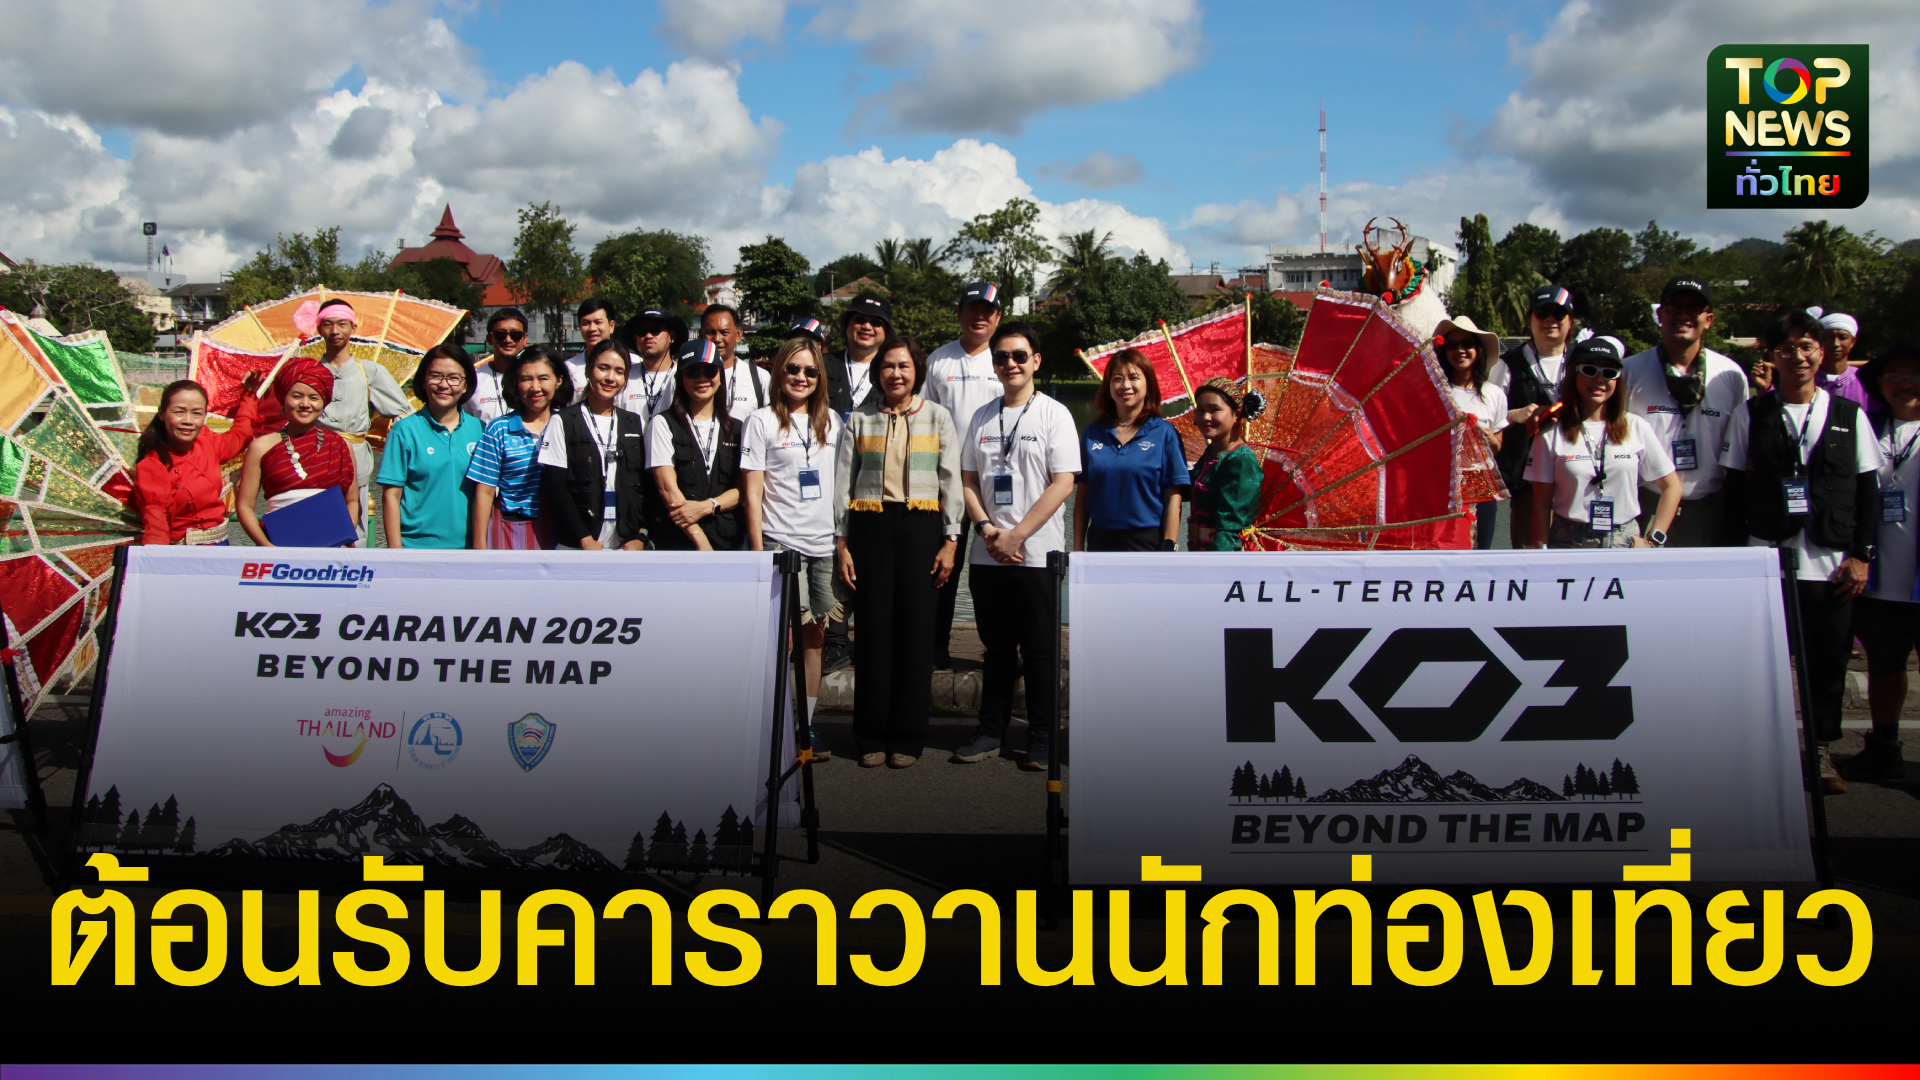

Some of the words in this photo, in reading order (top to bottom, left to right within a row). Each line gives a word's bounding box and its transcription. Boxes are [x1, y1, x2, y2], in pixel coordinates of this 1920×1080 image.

[1676, 280, 1703, 291] CELINE
[241, 562, 375, 583] BFGoodrich
[1224, 579, 1529, 603] ALL-TERRAIN
[1556, 577, 1626, 602] T/A
[234, 611, 322, 640] KO3
[338, 614, 537, 644] CARAVAN
[542, 617, 643, 645] 2025
[256, 654, 420, 682] BEYOND
[432, 658, 512, 684] THE
[525, 660, 613, 685] MAP
[1224, 625, 1635, 743] KO3
[324, 706, 371, 721] amazing
[297, 719, 396, 739] THAILAND
[1230, 814, 1428, 845] BEYOND
[1438, 813, 1533, 844] THE
[1542, 812, 1646, 844] MAP
